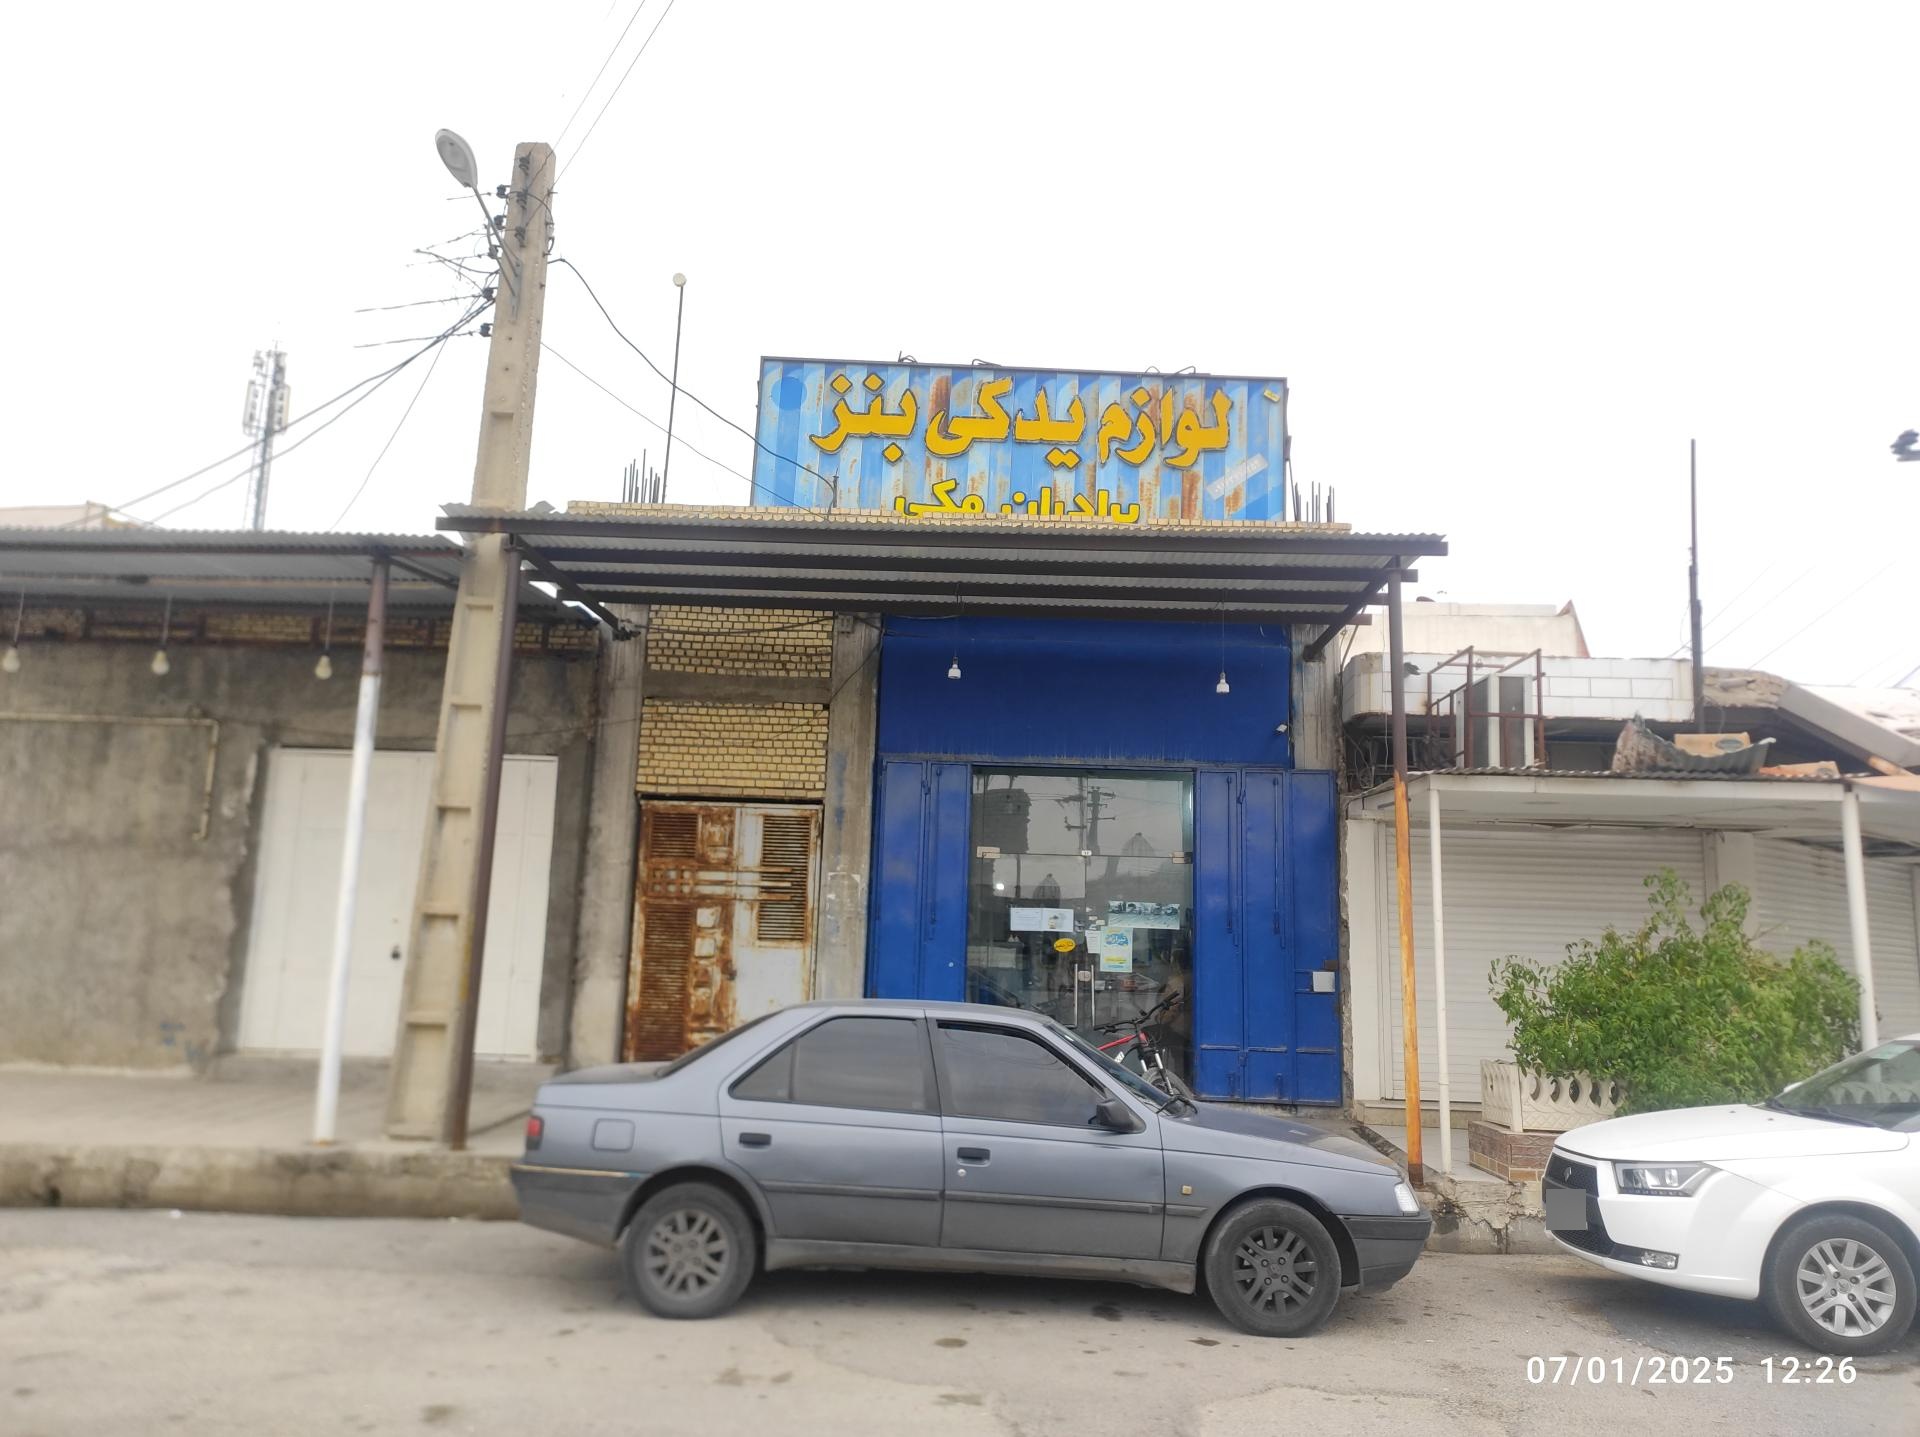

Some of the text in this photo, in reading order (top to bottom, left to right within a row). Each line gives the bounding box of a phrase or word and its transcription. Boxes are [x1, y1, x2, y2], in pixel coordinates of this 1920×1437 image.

[809, 373, 1233, 469] لوازم یدکی بنز
